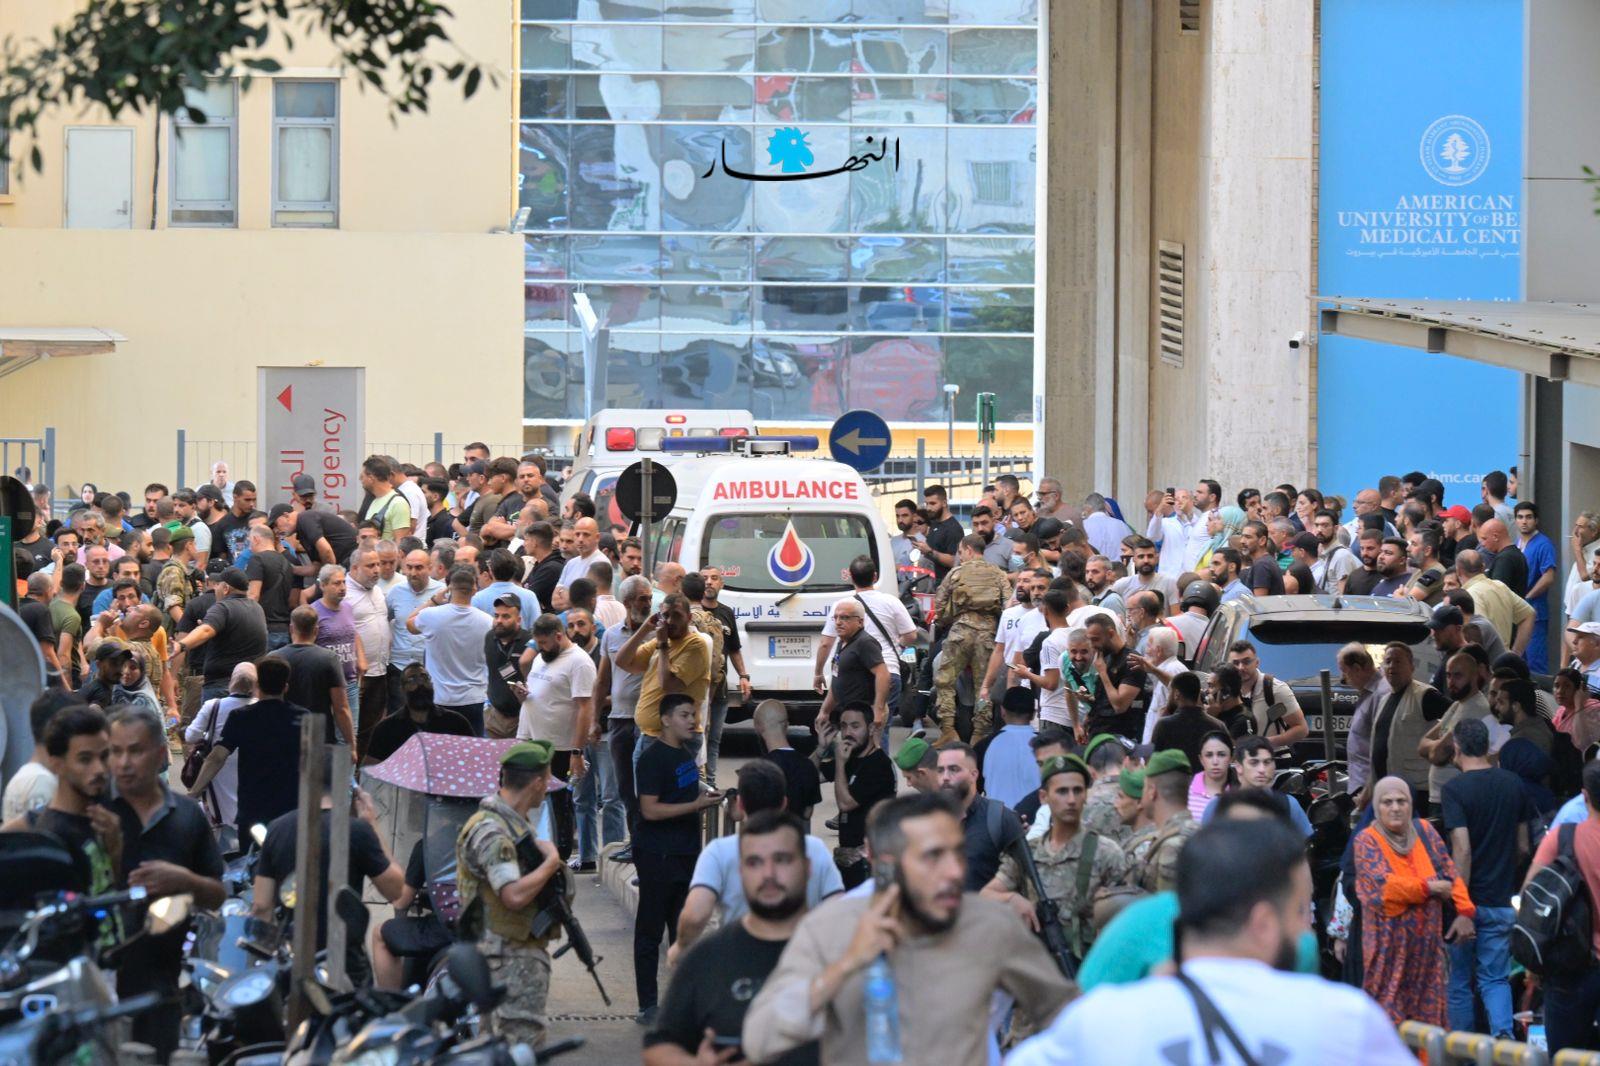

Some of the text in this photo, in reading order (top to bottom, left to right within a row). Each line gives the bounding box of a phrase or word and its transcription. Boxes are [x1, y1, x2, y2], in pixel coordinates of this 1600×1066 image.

[1395, 194, 1514, 210] AMERICAN
[1337, 211, 1521, 228] UNIVERSITY OF BE
[1359, 229, 1458, 244] MEDICAL
[713, 480, 858, 500] AMBULANCE
[1330, 692, 1359, 705] Jeep
